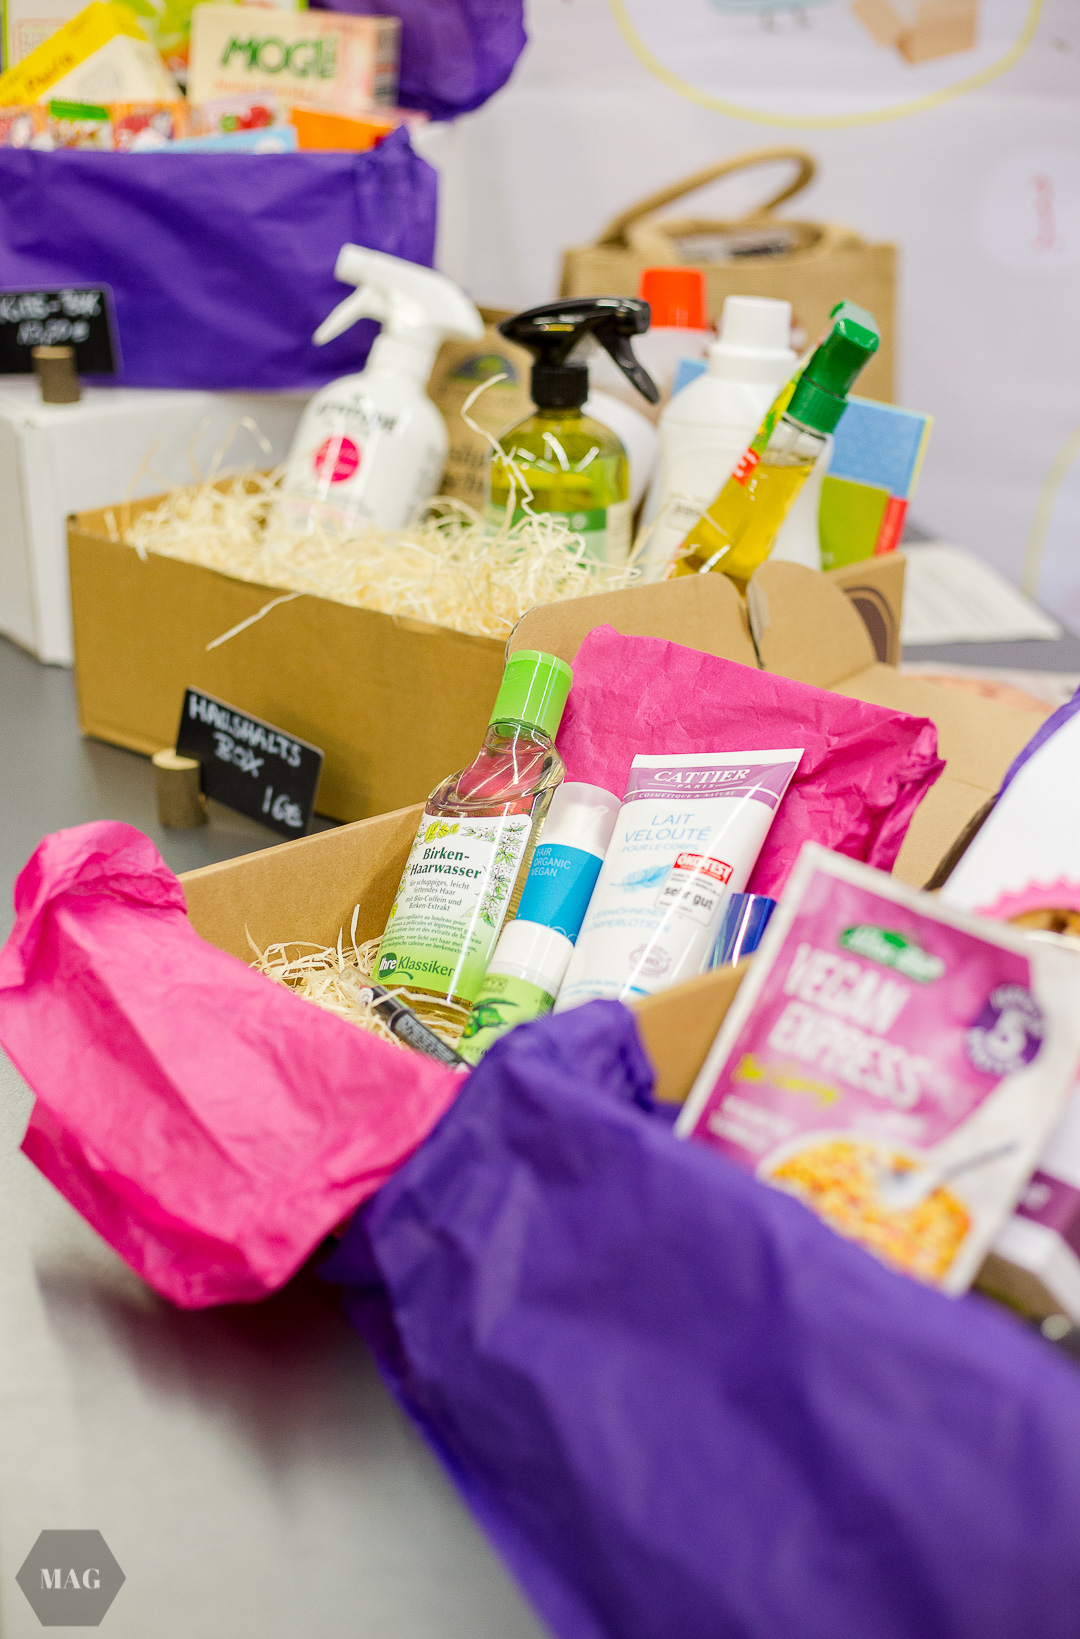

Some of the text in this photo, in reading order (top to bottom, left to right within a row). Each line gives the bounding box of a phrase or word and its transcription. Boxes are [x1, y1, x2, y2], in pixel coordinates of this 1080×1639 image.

[189, 694, 302, 768] HAUSHALTS
[213, 731, 264, 779] BOX
[654, 769, 751, 784] CATTIER
[704, 790, 735, 798] NATURE
[651, 813, 696, 826] LAIT
[625, 825, 712, 843] VELOUTÉ
[423, 847, 469, 861] Birken-
[536, 847, 552, 857] FAIR
[534, 858, 571, 870] ORGANIC
[410, 863, 482, 879] Haarwasser
[531, 867, 558, 877] VEGAN
[413, 886, 456, 895] fettendes Haar
[416, 878, 448, 888] schuppiges,
[450, 880, 470, 890] leicht
[414, 895, 447, 904] Bio-Coffein
[664, 887, 690, 899] ser
[693, 895, 714, 911] gut
[409, 903, 450, 911] Birken-Extrakt
[431, 914, 452, 922] bouleau
[452, 918, 466, 926] pour
[379, 956, 455, 976] Ihre Klassiker
[783, 941, 911, 1038] VEGAN
[767, 999, 931, 1109] EXPRESS
